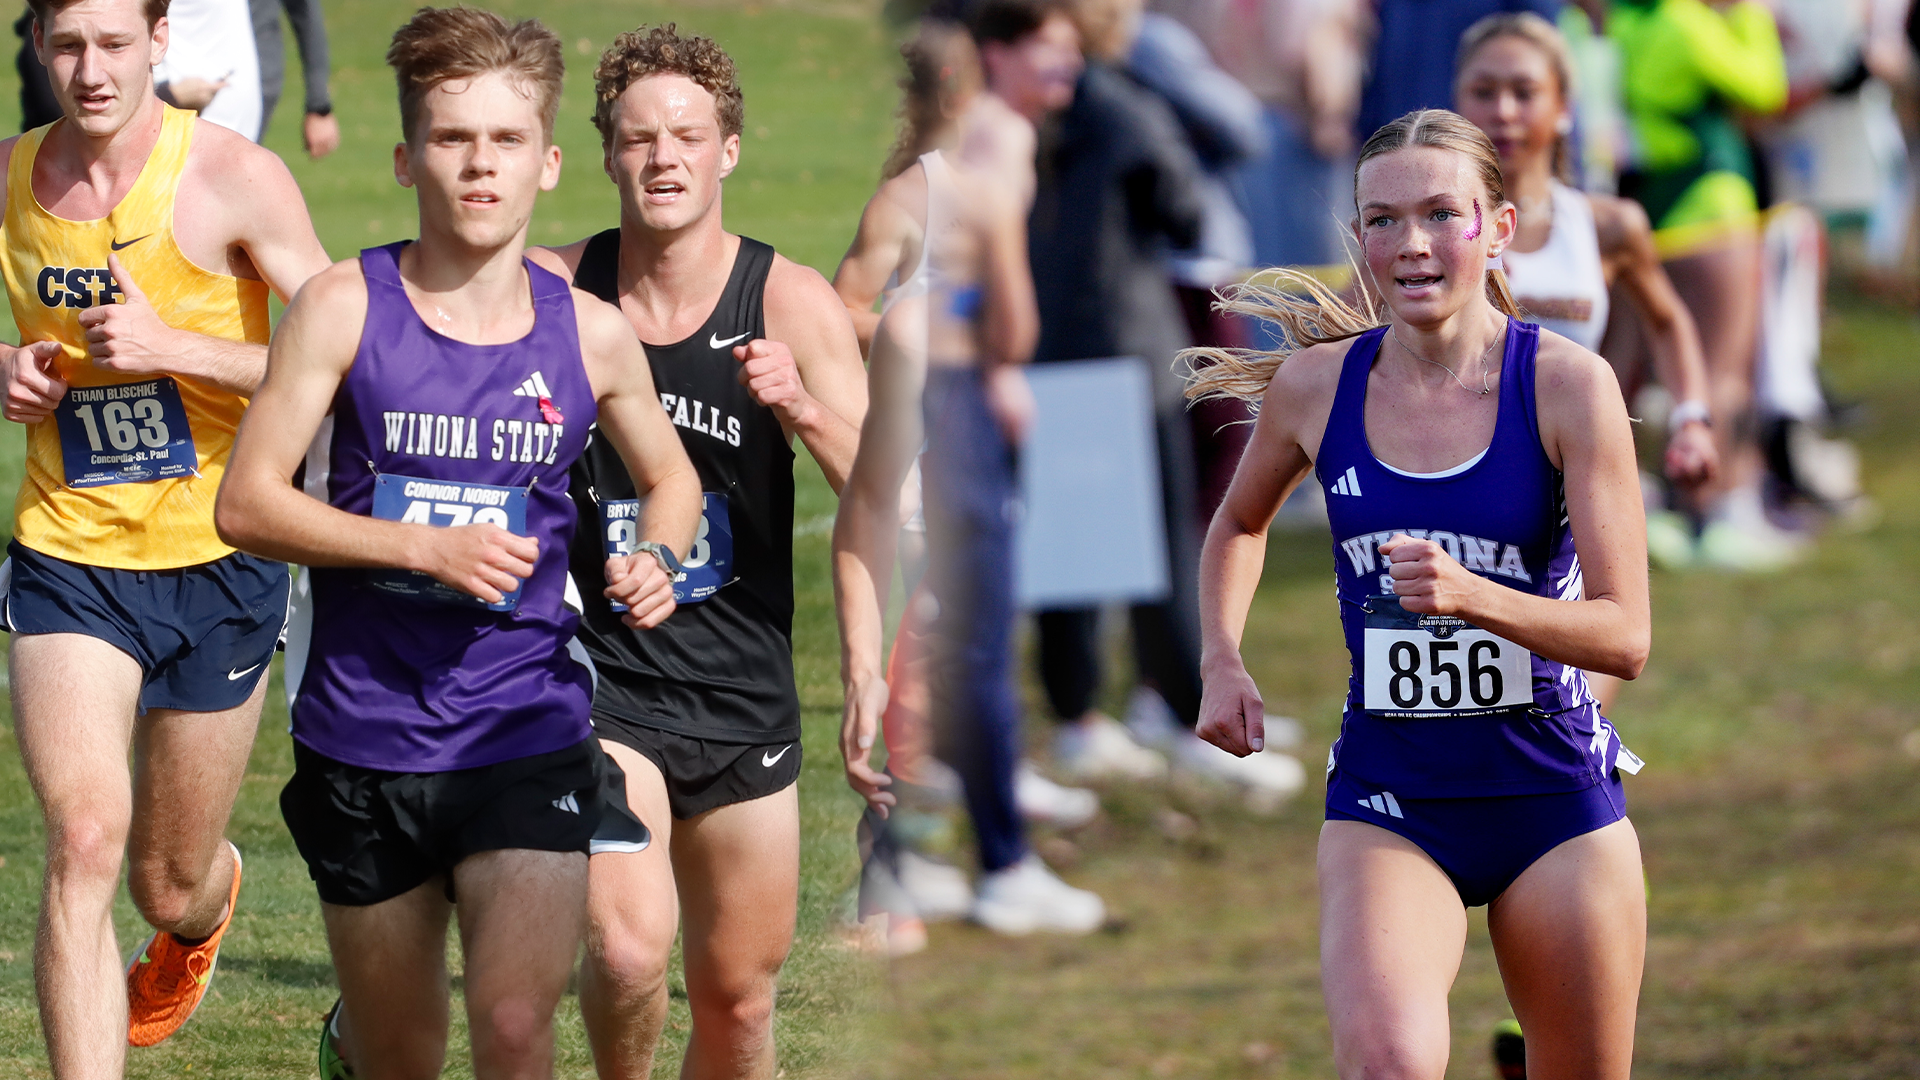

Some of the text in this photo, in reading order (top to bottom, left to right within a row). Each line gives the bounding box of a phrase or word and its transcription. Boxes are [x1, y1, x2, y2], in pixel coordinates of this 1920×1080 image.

[71, 382, 158, 402] ETHAN BLISCHKE
[74, 398, 170, 452] 163
[383, 411, 564, 465] WINONA STATE
[660, 392, 741, 448] FALLS
[150, 449, 169, 460] Paul
[404, 481, 511, 507] CONNOR NORBY
[1388, 639, 1504, 709] 856
